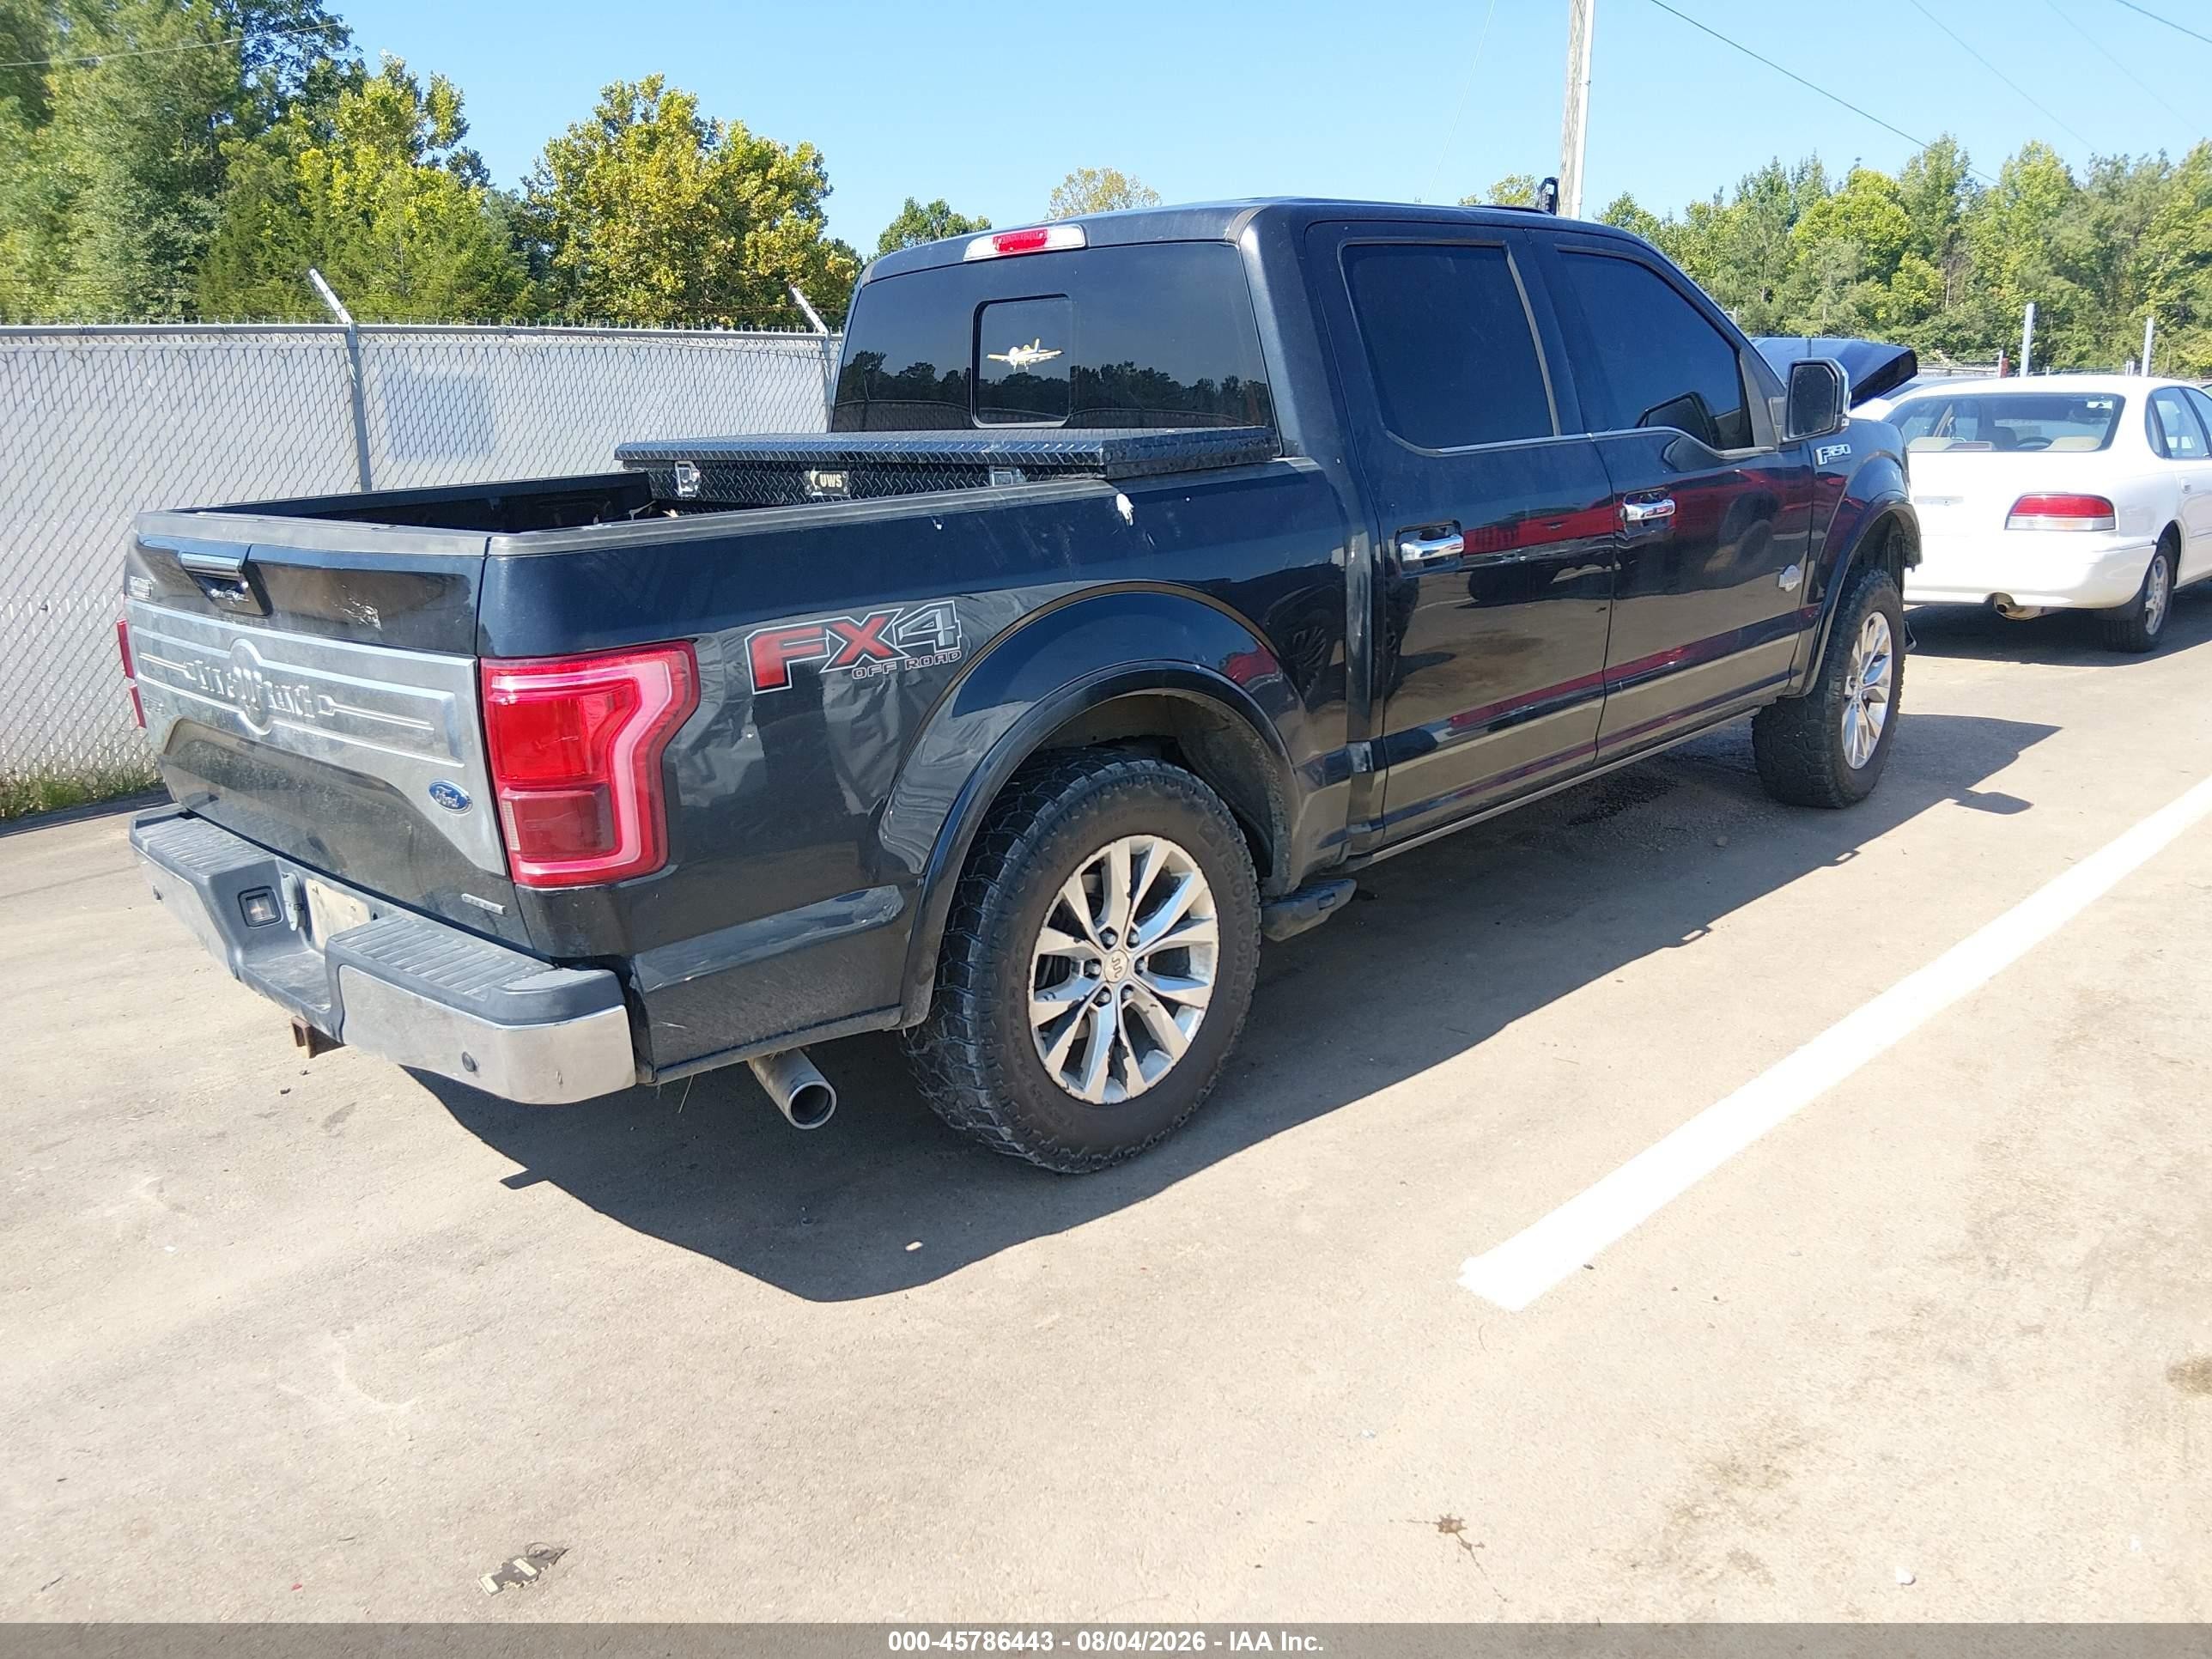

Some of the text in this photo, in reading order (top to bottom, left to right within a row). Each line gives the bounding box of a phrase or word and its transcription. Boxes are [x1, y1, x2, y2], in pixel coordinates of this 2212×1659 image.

[819, 473, 842, 488] UWS
[744, 599, 962, 696] FX4
[852, 650, 962, 680] OFF ROAD
[434, 785, 460, 808] Ford
